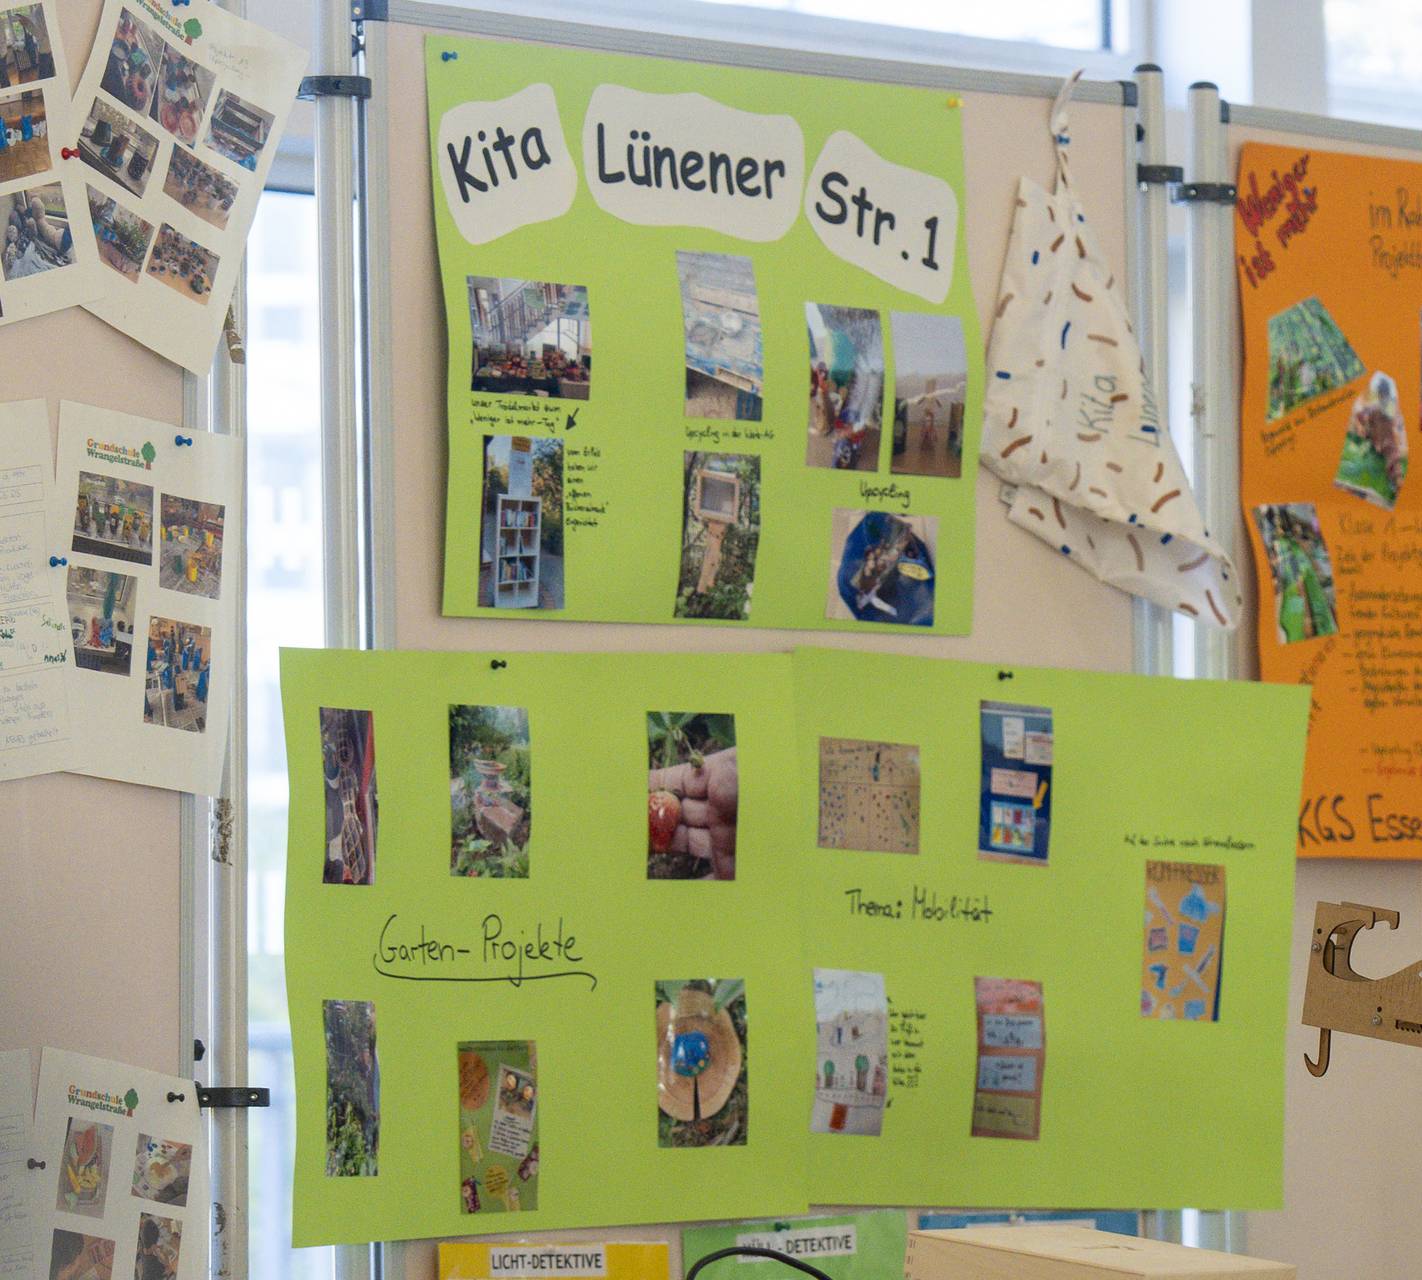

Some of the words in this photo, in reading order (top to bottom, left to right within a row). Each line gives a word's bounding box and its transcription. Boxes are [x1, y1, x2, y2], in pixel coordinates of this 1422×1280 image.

[447, 125, 552, 203] Kita
[596, 121, 786, 200] Lünener
[1298, 794, 1356, 848] KGS
[845, 888, 902, 919] Thema:
[911, 884, 994, 924] Mobilität
[491, 1253, 603, 1270] LICHT-DETEKTIVE
[785, 1234, 853, 1255] DETEKTIVE
